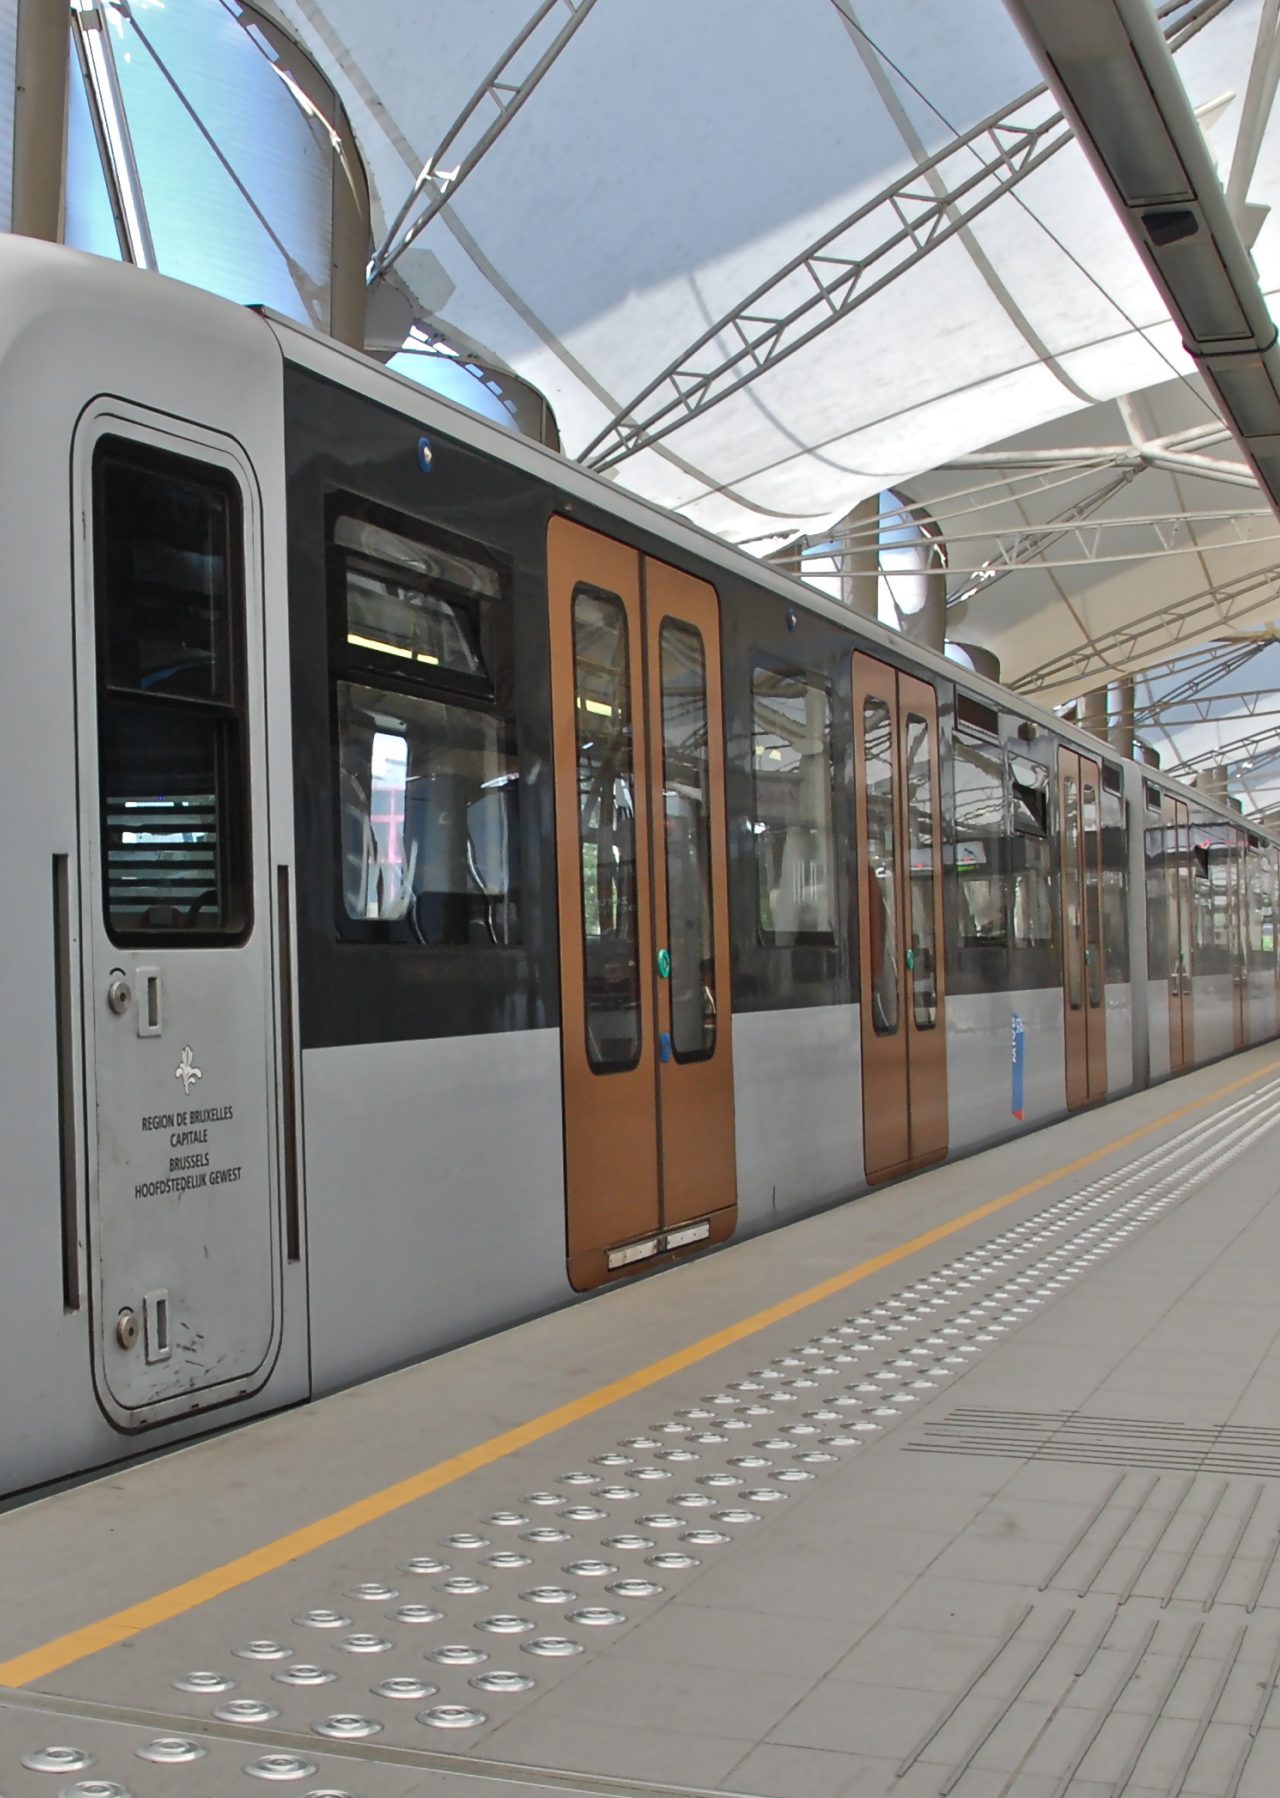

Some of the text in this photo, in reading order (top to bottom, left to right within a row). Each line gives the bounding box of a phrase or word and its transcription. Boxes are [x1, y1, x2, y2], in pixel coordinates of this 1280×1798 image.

[142, 1105, 233, 1131] REGION DE BRUXELLES
[170, 1129, 208, 1147] CAPITALE
[169, 1152, 209, 1172] BRUSSELS
[135, 1166, 242, 1199] HOOFDSTEDELIJK GEWEST
